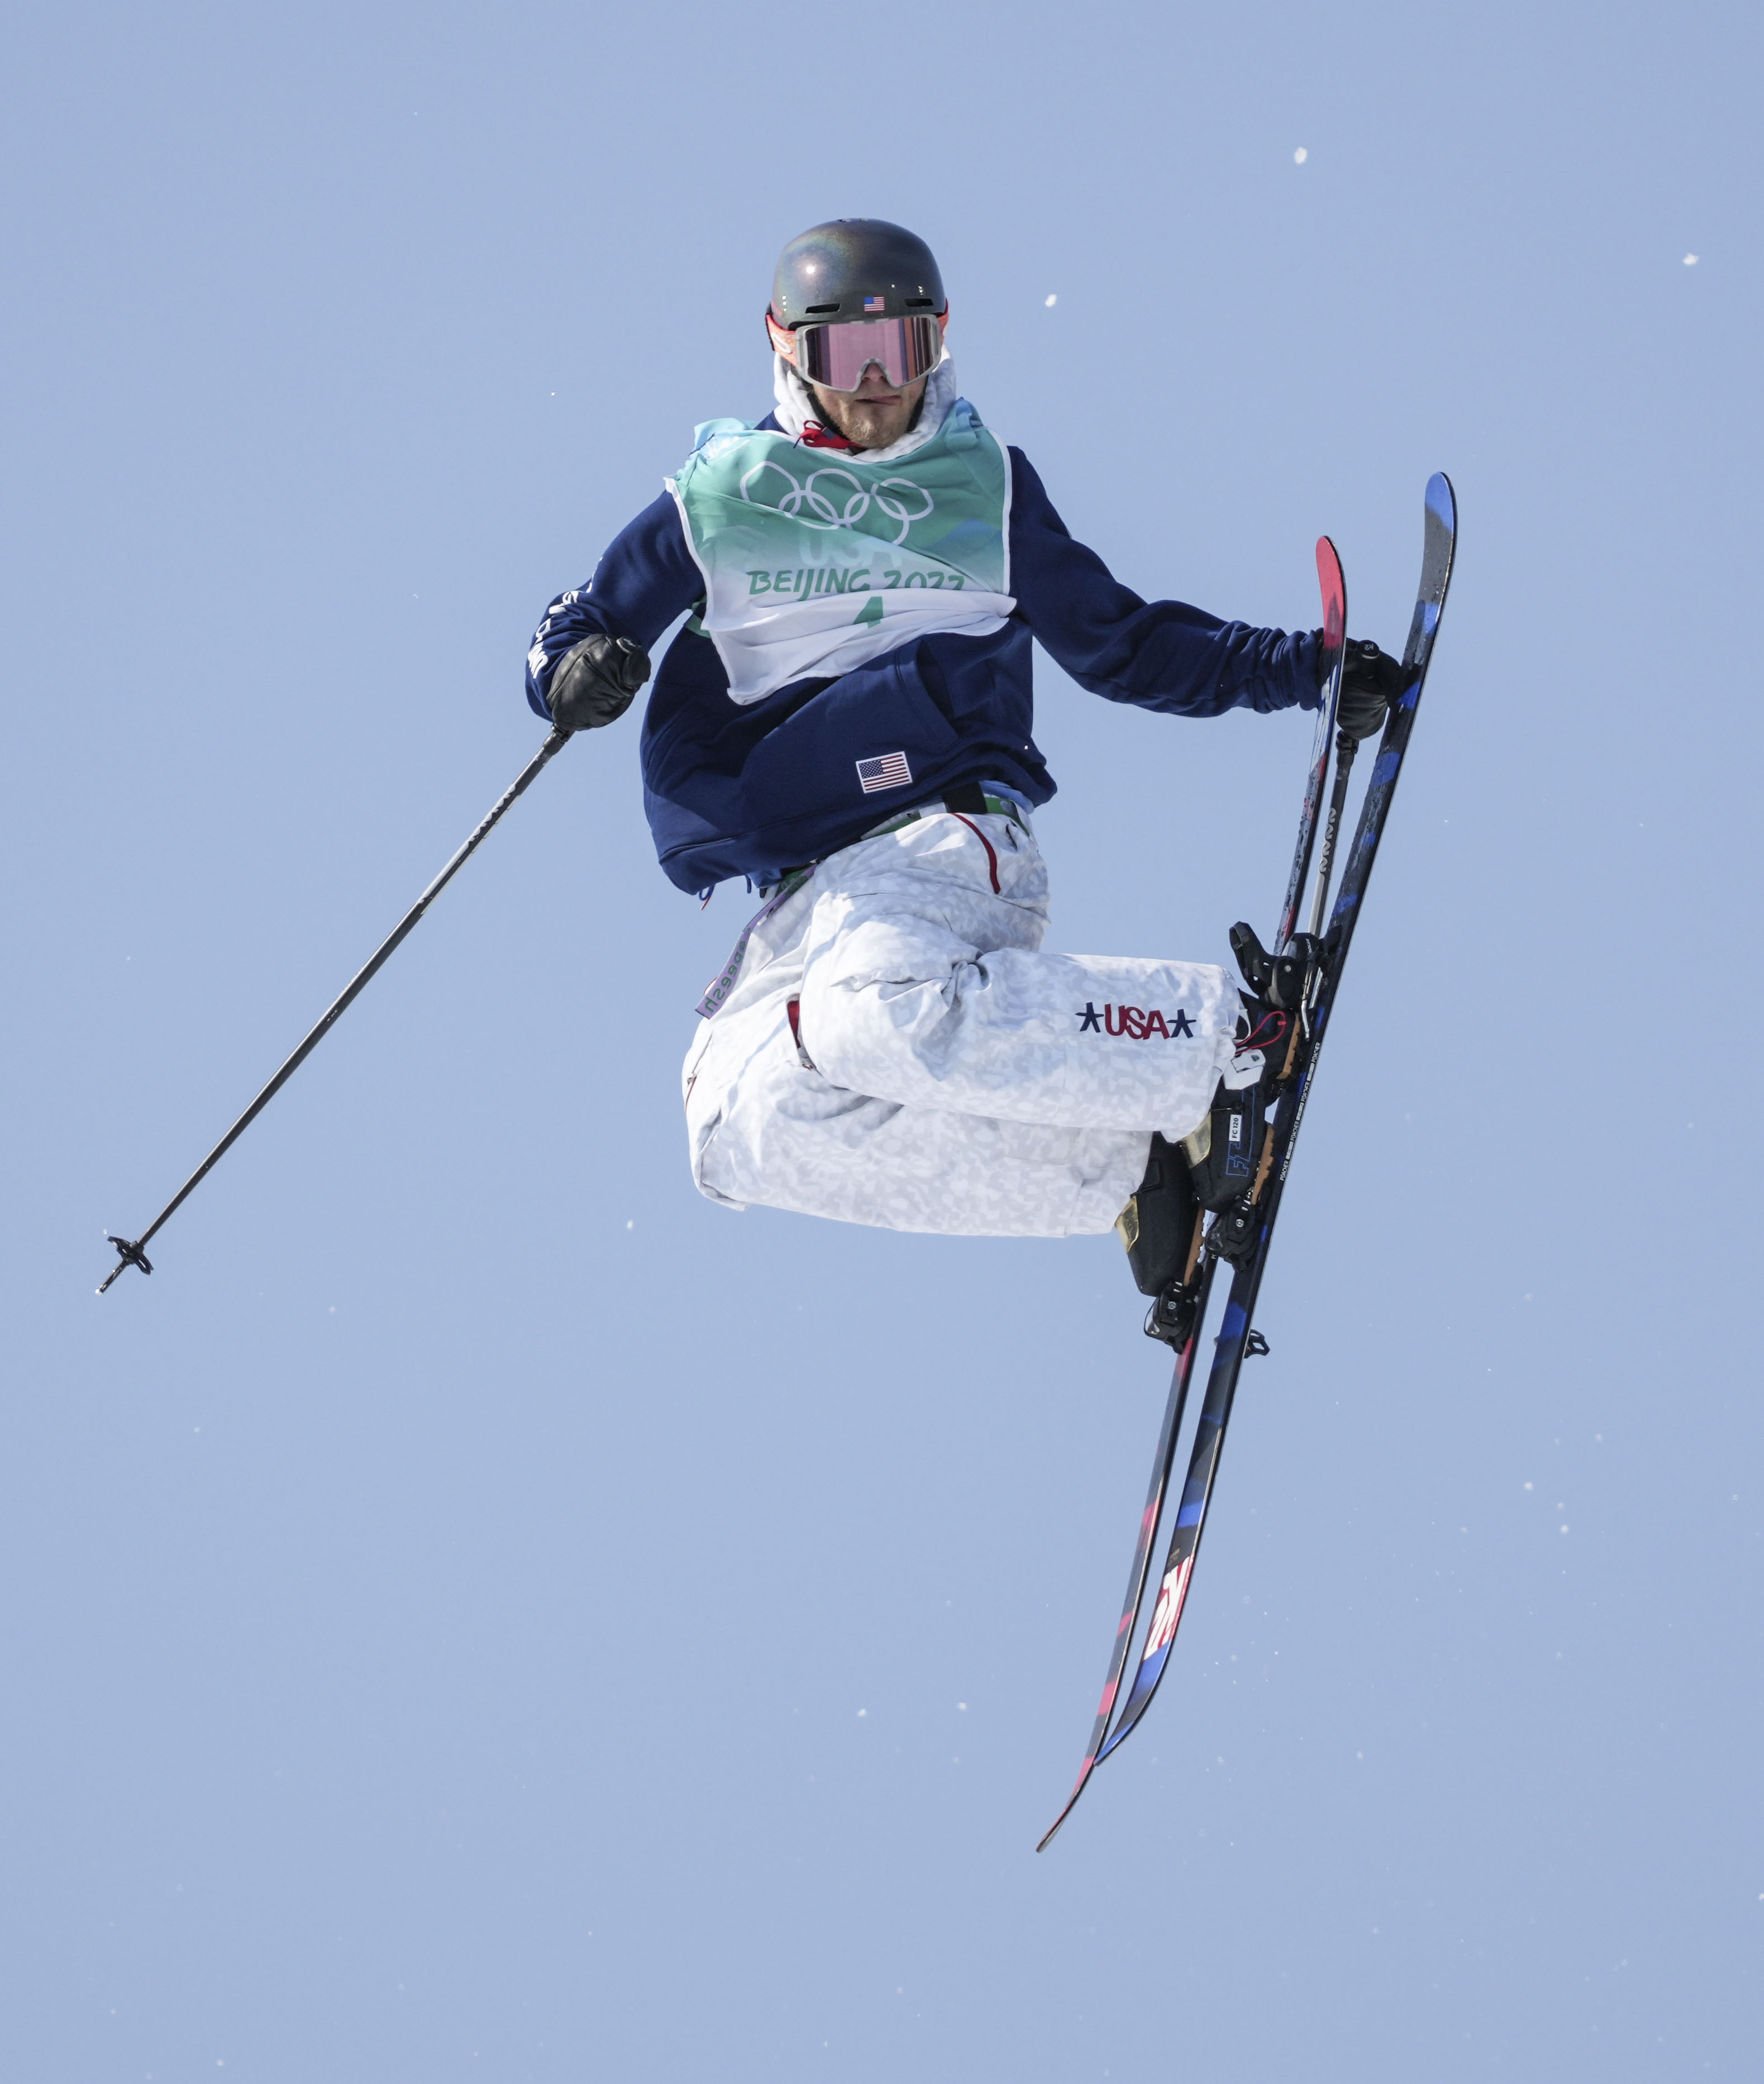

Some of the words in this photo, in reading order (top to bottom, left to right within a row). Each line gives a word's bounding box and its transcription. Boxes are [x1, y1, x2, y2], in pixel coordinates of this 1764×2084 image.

[746, 569, 871, 602] BEIJING
[883, 570, 965, 591] 2022
[1104, 1004, 1171, 1040] USA
[1231, 1129, 1238, 1138] FC
